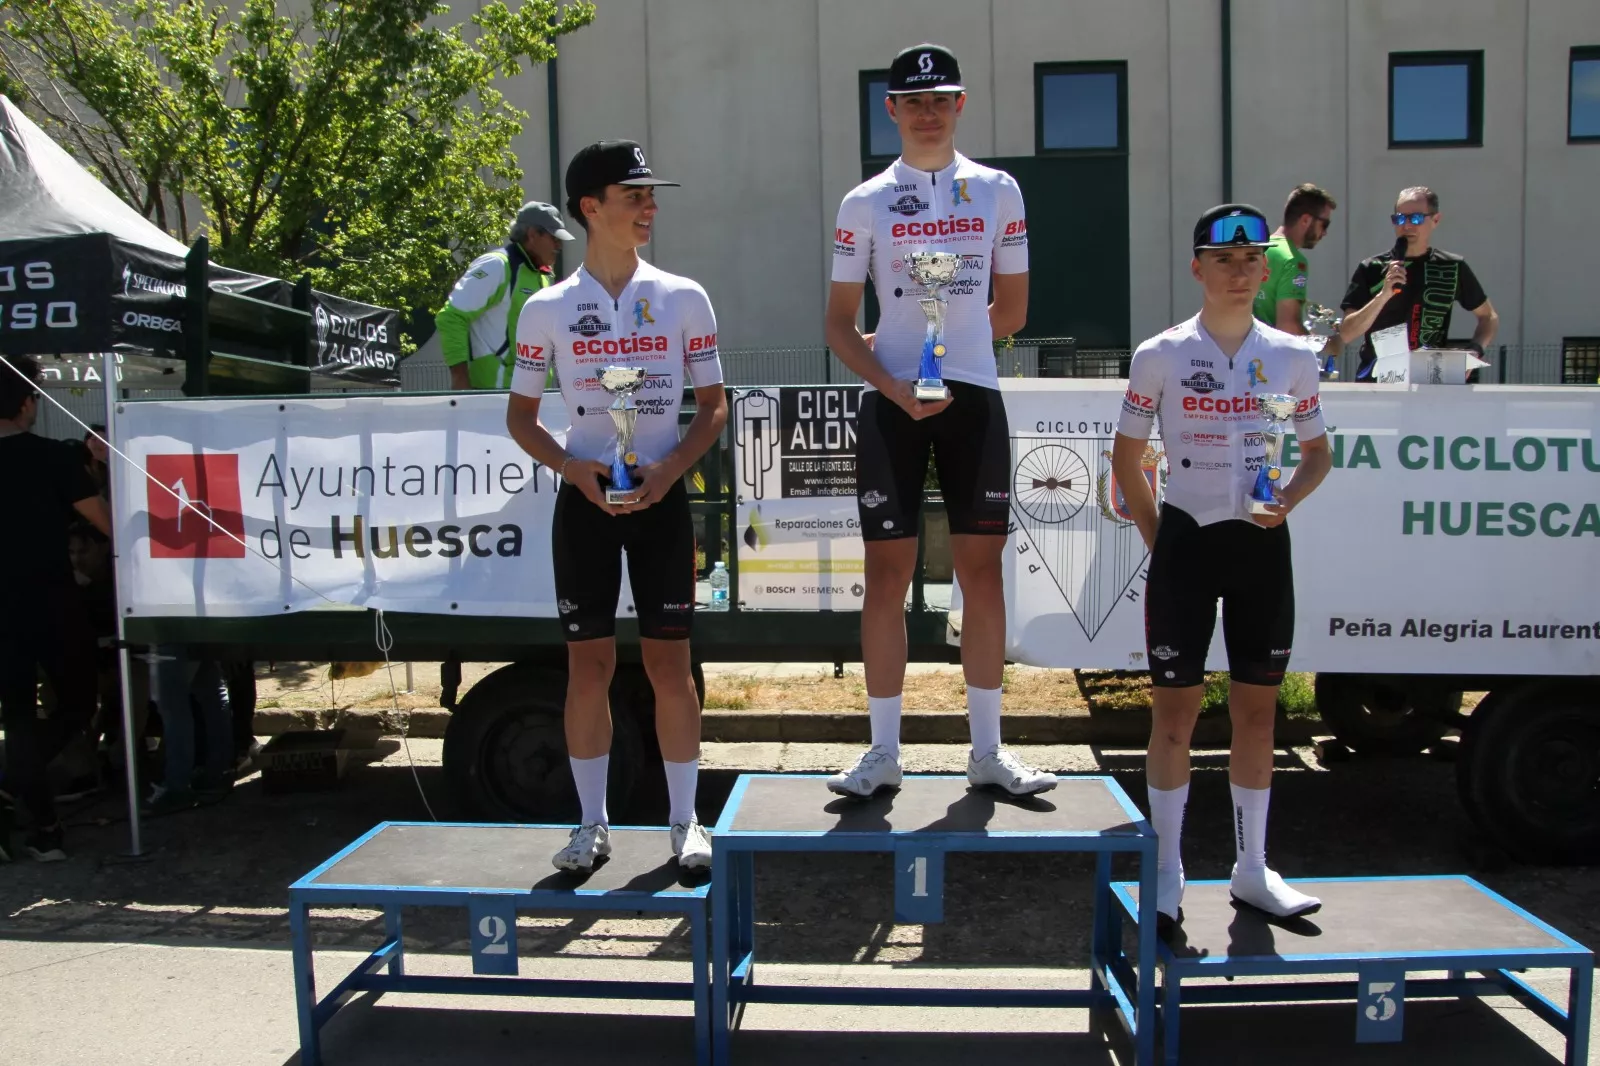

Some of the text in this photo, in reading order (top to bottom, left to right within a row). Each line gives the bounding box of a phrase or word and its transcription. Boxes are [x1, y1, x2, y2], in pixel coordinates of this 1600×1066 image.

[905, 74, 947, 84] SCOTT
[894, 184, 918, 193] GOBIK
[891, 215, 985, 238] ecotisa
[893, 239, 928, 247] EMPRESA
[577, 302, 599, 312] GOBIK
[122, 311, 183, 334] ORBEA
[329, 314, 388, 344] CICLOS
[572, 332, 668, 356] ecotisa
[327, 342, 396, 371] ALONSO
[575, 357, 610, 365] EMPRESA
[1190, 359, 1214, 369] GOBIK
[1182, 391, 1259, 414] ecotis
[1183, 414, 1219, 422] EMPRESA
[790, 421, 857, 450] ALON
[788, 461, 805, 473] CALLE
[805, 461, 813, 472] DE
[814, 461, 821, 472] LA
[821, 461, 841, 472] FUENTE
[255, 449, 559, 511] Ayuntamien
[775, 519, 844, 531] Reparaciones
[1401, 501, 1600, 537] HUESCA
[259, 514, 524, 560] de Huesca
[766, 586, 796, 594] BOSCH
[802, 586, 845, 594] SIEMENS
[1329, 618, 1392, 637] Peña
[1400, 618, 1493, 643] Alegria
[908, 856, 929, 897] 1
[478, 915, 509, 954] 2
[1365, 982, 1397, 1021] 3
